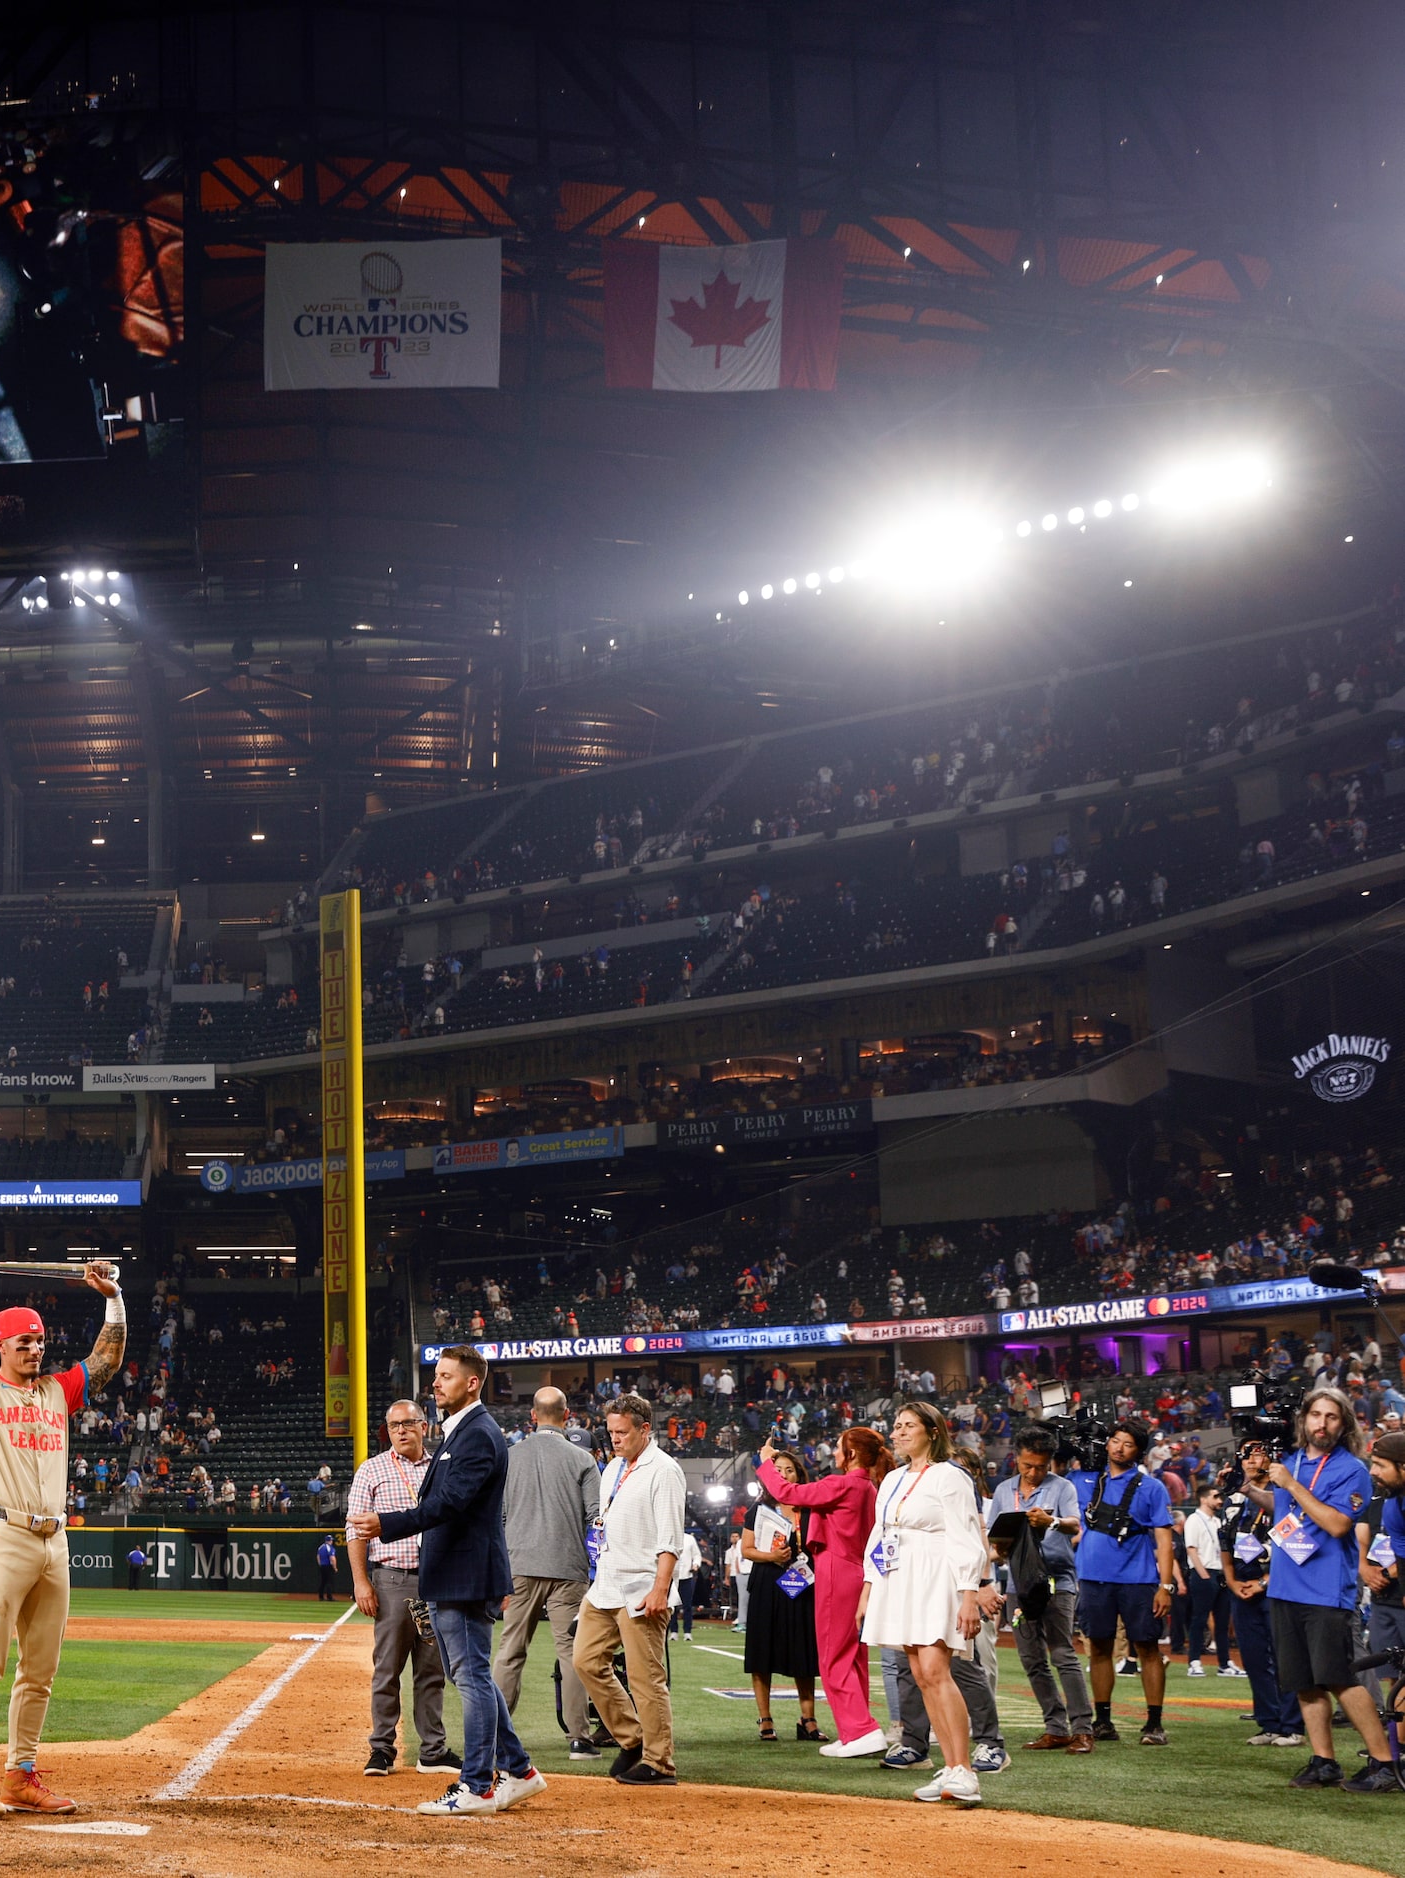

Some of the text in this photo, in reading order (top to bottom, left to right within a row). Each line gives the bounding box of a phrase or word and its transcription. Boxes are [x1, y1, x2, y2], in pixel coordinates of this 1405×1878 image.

[303, 301, 459, 313] WORLD SERIES
[293, 312, 469, 337] CHAMPIONS
[329, 953, 340, 1036] THE
[1291, 1033, 1391, 1079] JACK DANIEL'S
[31, 1071, 75, 1087] know.
[330, 1064, 341, 1147] HOT
[734, 1114, 788, 1132] PERRY
[802, 1106, 860, 1124] PERRY
[667, 1121, 720, 1139] PERRY
[745, 1129, 780, 1140] HOMES
[813, 1122, 851, 1133] HOMES
[454, 1142, 499, 1157] BAKER
[529, 1136, 609, 1153] Great Service
[677, 1136, 712, 1147] HOMES
[382, 1160, 399, 1169] App
[454, 1154, 499, 1165] BROTHERS
[29, 1194, 53, 1204] WITH
[55, 1194, 74, 1204] THE
[75, 1194, 118, 1203] CHICAGO
[331, 1174, 342, 1290] ZONE
[1238, 1286, 1299, 1302] NATIONAL
[1097, 1300, 1145, 1321] GAME
[1173, 1295, 1206, 1311] 2024
[713, 1329, 826, 1346] NATIONAL LEAGUE
[872, 1322, 984, 1338] AMERICAN LEAGUE
[574, 1337, 622, 1356] GAME
[649, 1336, 682, 1350] 2024
[9, 1430, 63, 1452] LEAGUE
